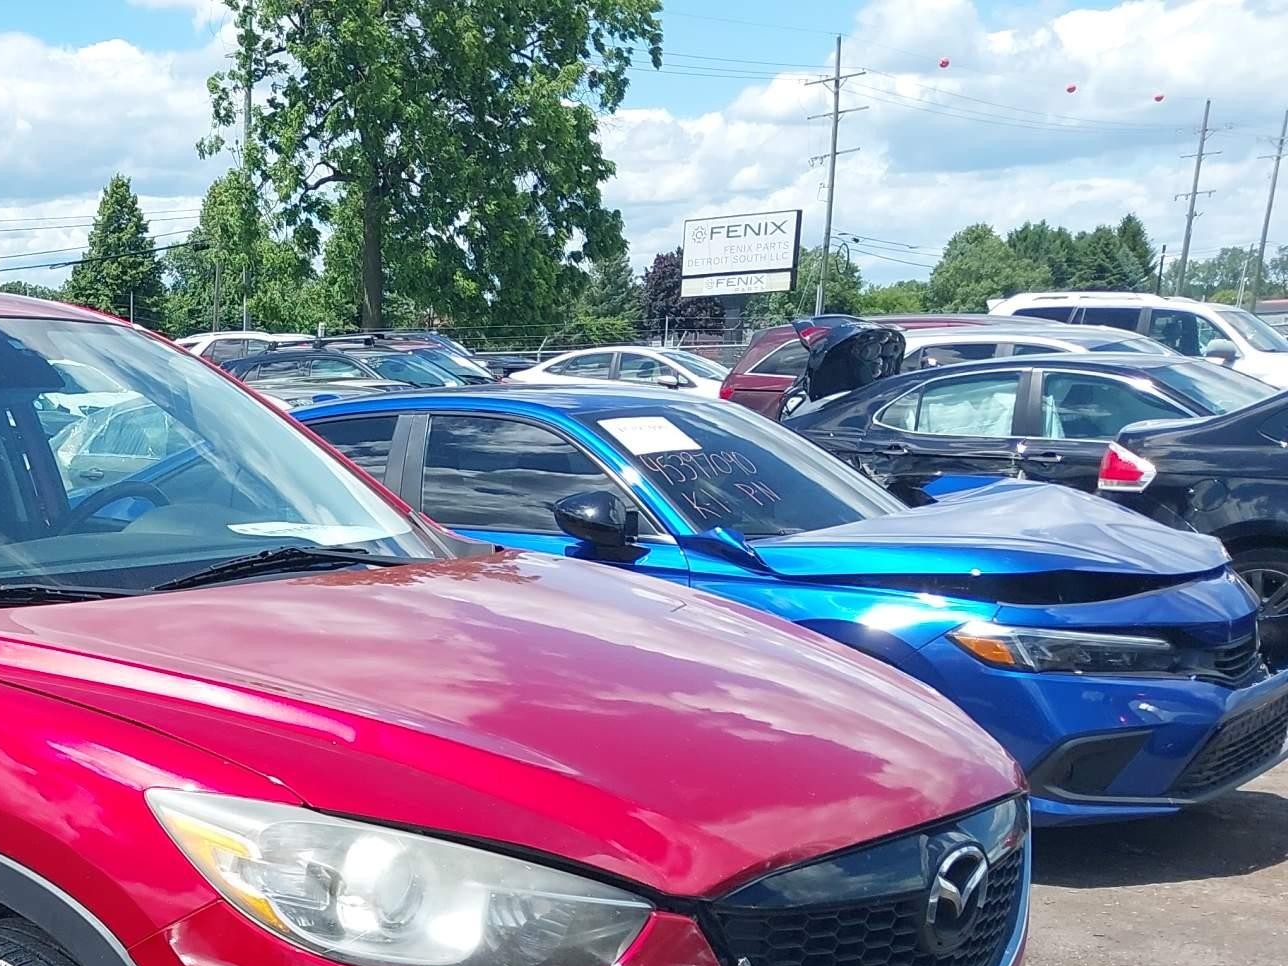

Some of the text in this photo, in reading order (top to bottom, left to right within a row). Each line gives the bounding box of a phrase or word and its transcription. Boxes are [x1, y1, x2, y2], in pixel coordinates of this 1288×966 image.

[710, 220, 788, 240] FENIX
[724, 241, 789, 254] FENIX PARTS
[687, 251, 789, 267] DETROIT SOUTH LLC
[715, 275, 765, 288] FENIX
[639, 451, 758, 486] 45397090
